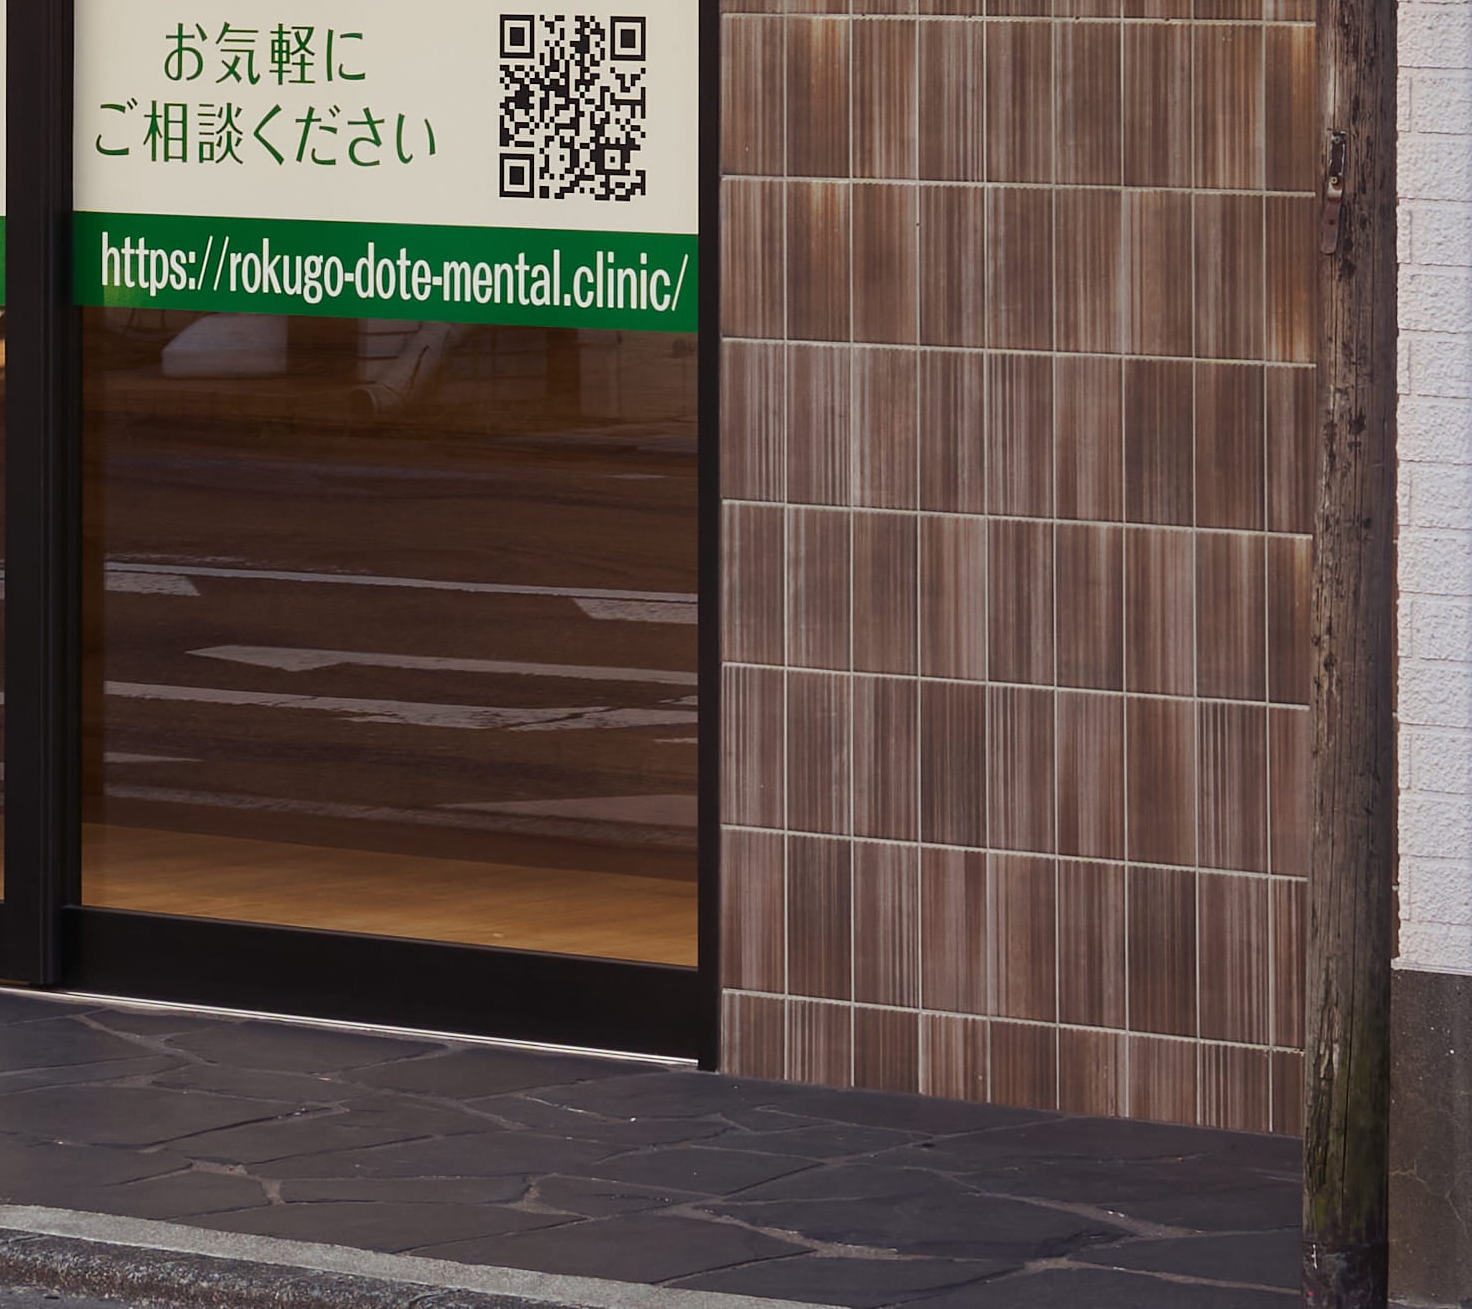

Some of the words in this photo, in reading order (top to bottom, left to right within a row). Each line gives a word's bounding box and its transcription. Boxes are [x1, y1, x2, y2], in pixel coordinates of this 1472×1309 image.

[164, 22, 366, 85] お気軽に
[96, 98, 436, 166] ご相談ください
[101, 231, 688, 311] https://rokugo-dote-mental.clinic/
